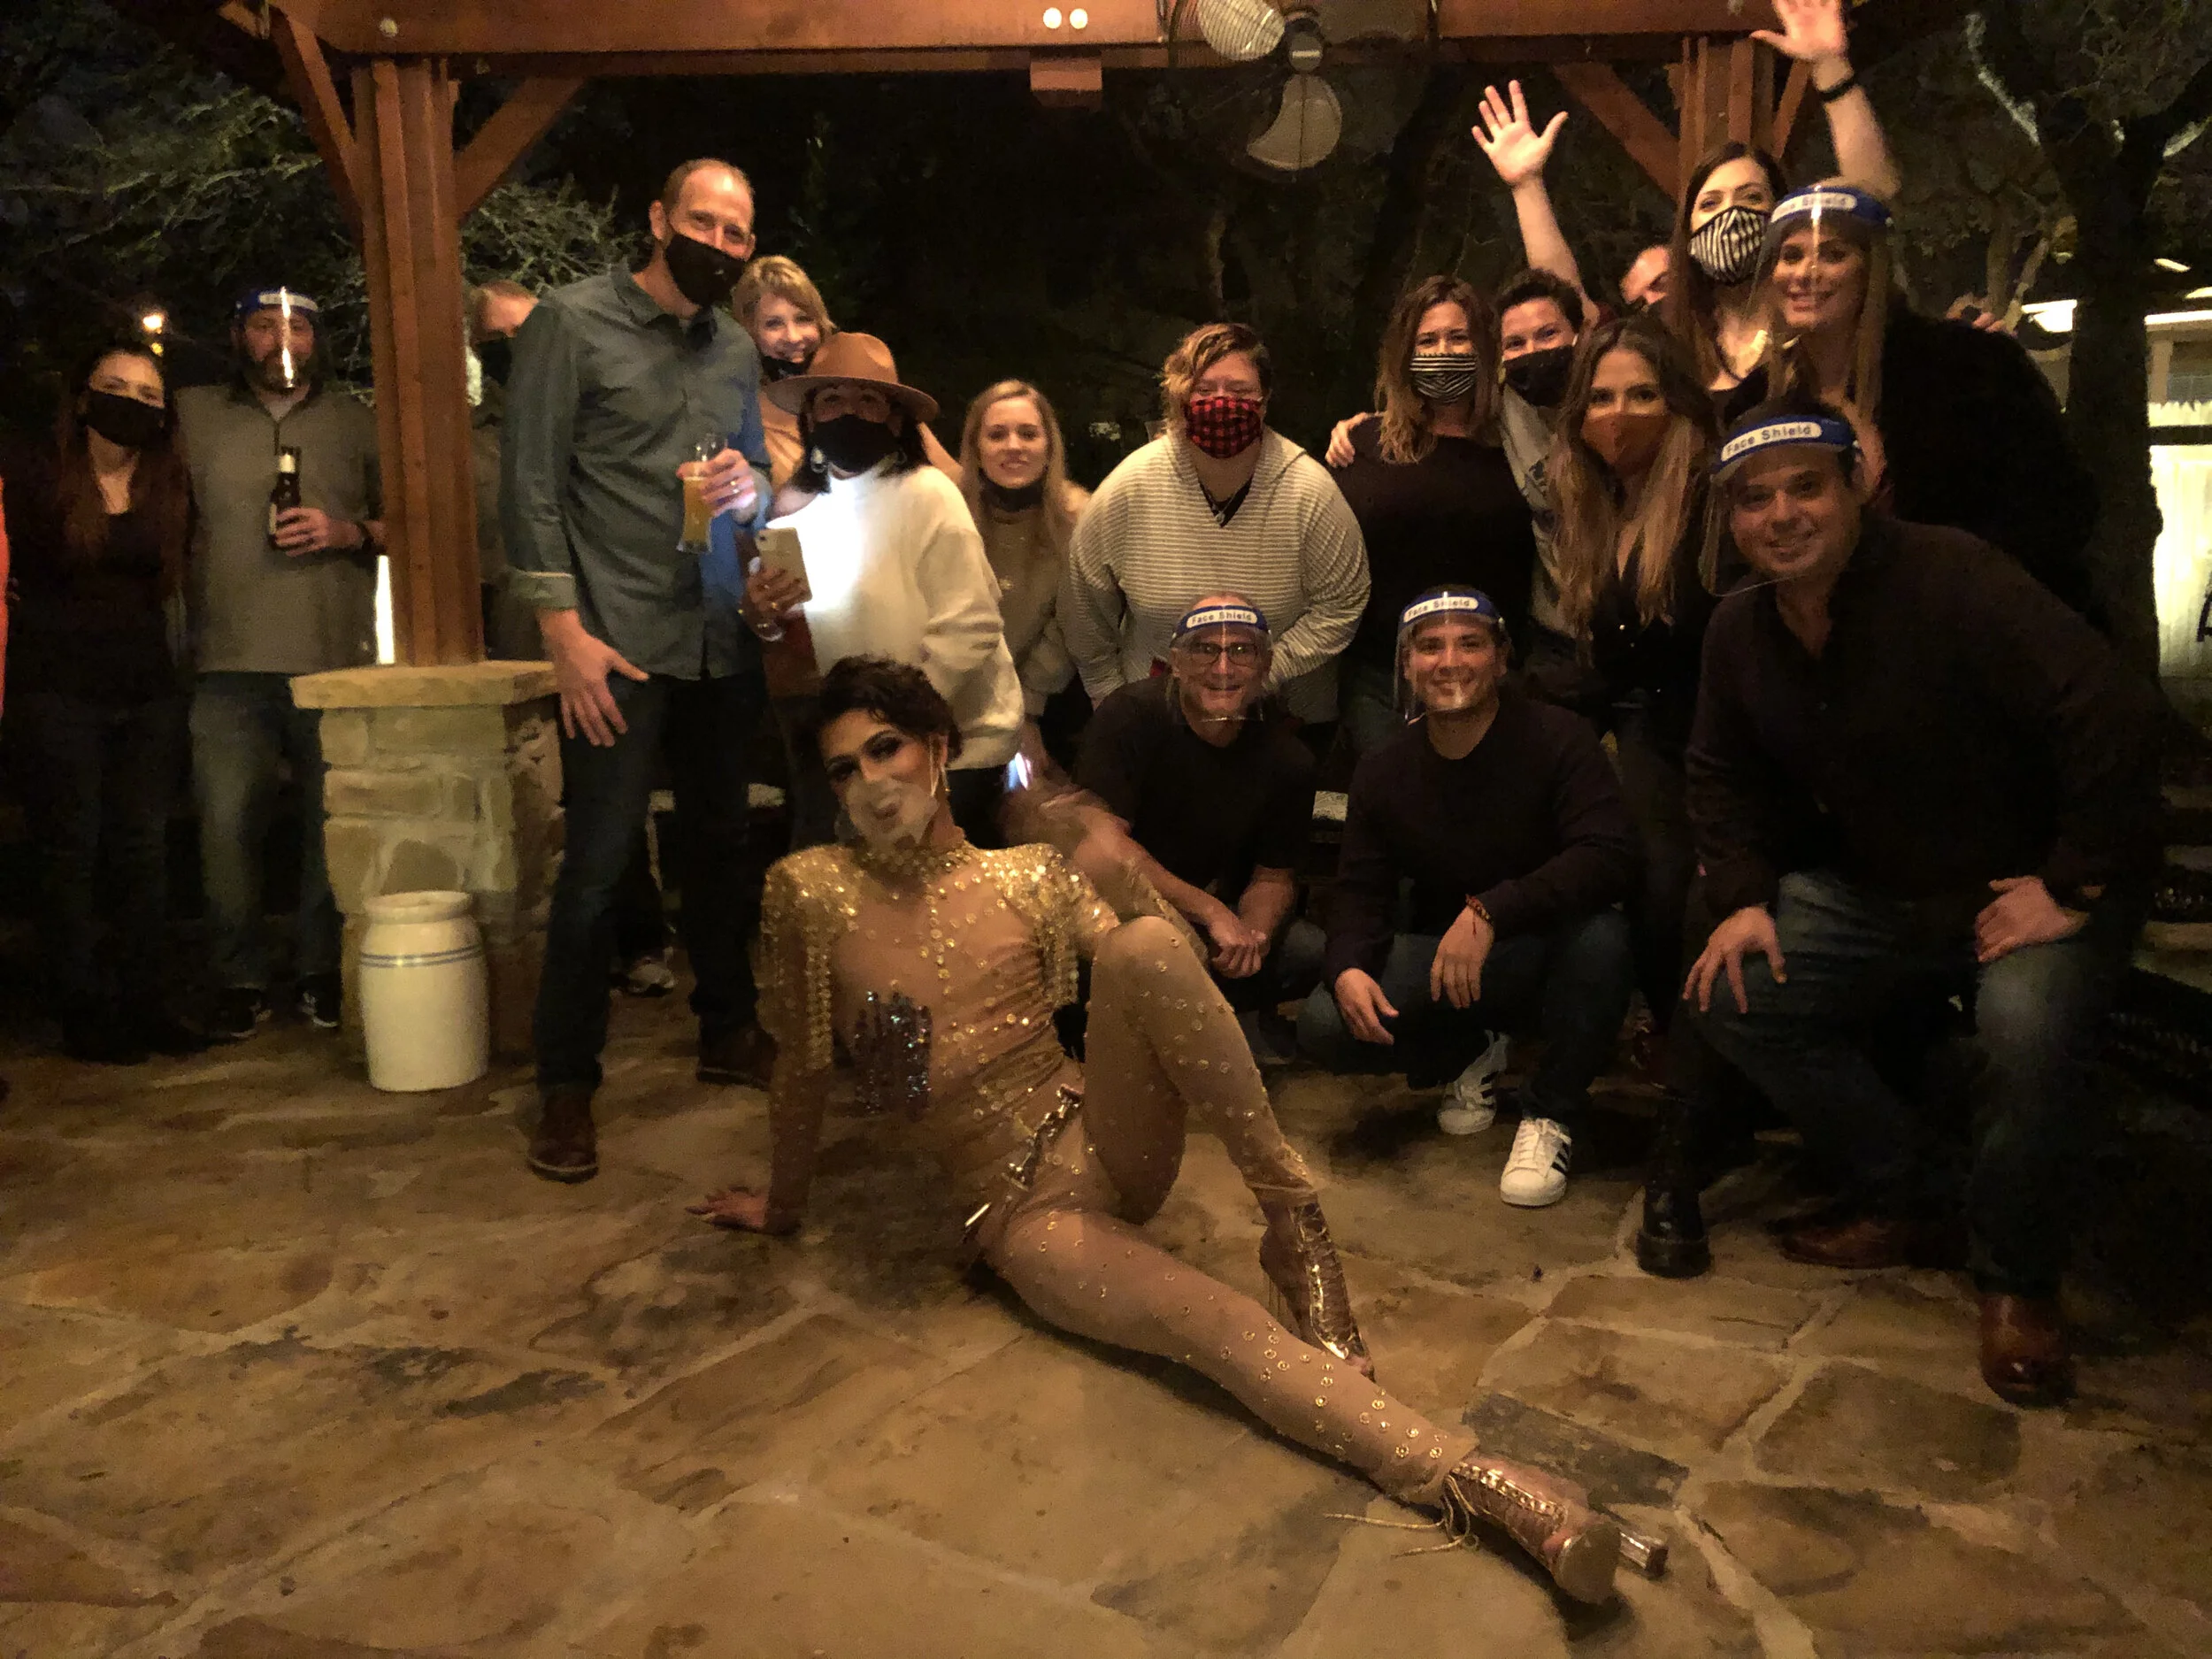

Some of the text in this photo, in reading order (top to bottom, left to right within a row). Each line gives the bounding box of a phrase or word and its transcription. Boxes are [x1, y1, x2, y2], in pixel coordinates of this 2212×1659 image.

[1726, 425, 1811, 455] Face Shield
[1191, 611, 1252, 625] Face Shield
